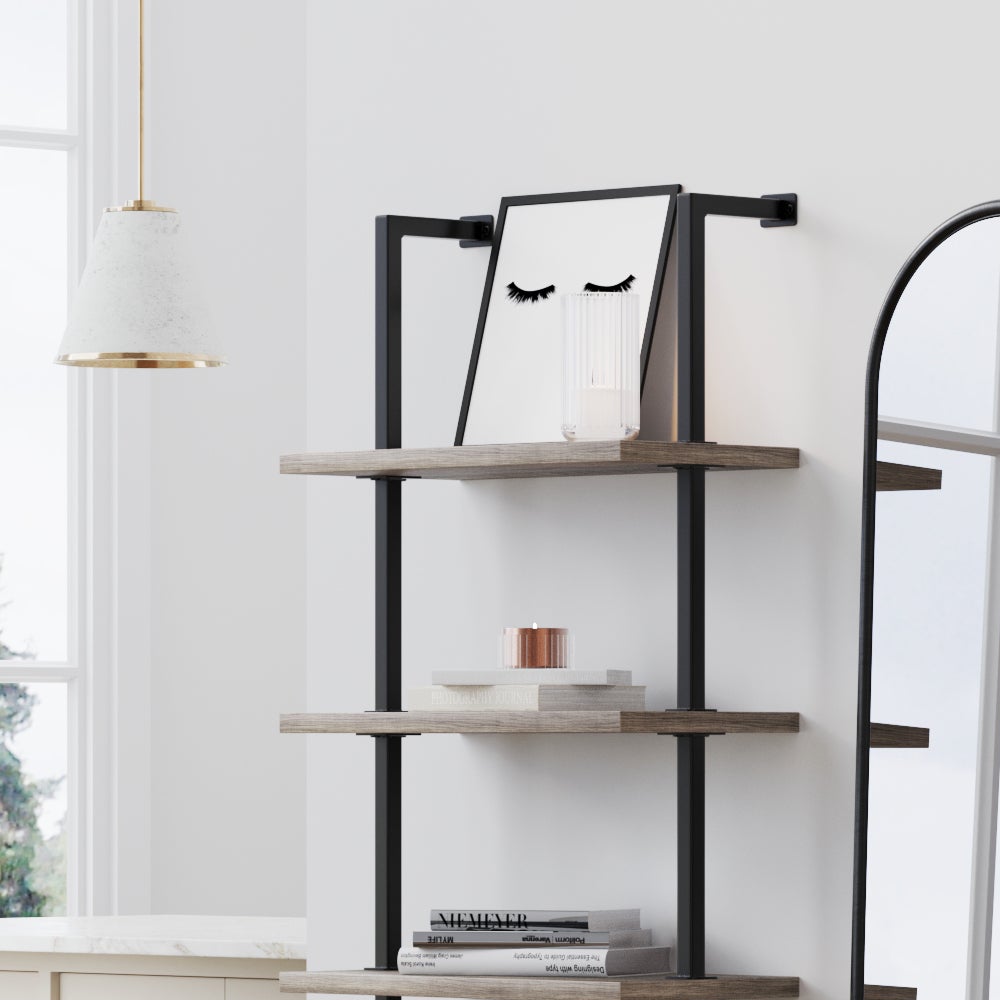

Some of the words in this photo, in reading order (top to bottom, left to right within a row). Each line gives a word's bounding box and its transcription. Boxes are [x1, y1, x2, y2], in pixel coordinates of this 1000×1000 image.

[431, 687, 493, 705] PHOTOGRAPHY
[438, 913, 529, 929] NIEMEYER
[513, 953, 543, 961] Typography
[545, 964, 559, 973] type
[560, 965, 572, 973] with
[573, 964, 605, 974] Designing
